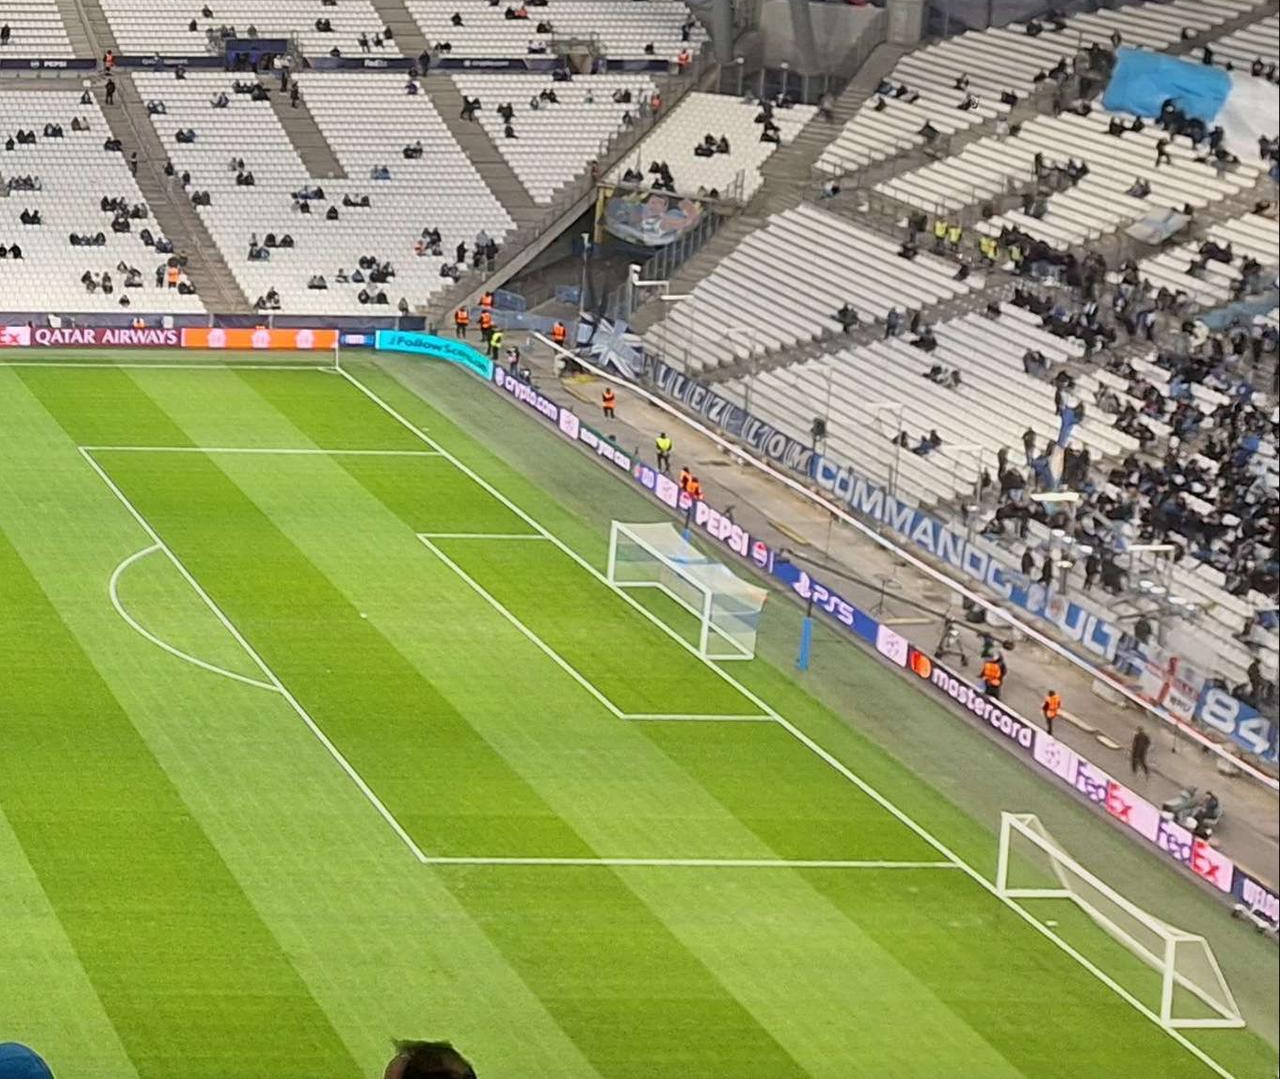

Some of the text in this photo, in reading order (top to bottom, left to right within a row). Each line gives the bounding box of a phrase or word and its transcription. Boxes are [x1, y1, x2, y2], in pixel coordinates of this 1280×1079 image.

[35, 328, 177, 345] QATAR AIRWAYS
[504, 375, 558, 421] crypto.com
[695, 501, 750, 557] PEPSI
[813, 585, 855, 626] PS5
[931, 668, 1033, 749] mastercard
[1075, 757, 1133, 819] FedEx
[1157, 818, 1220, 879] FedEx
